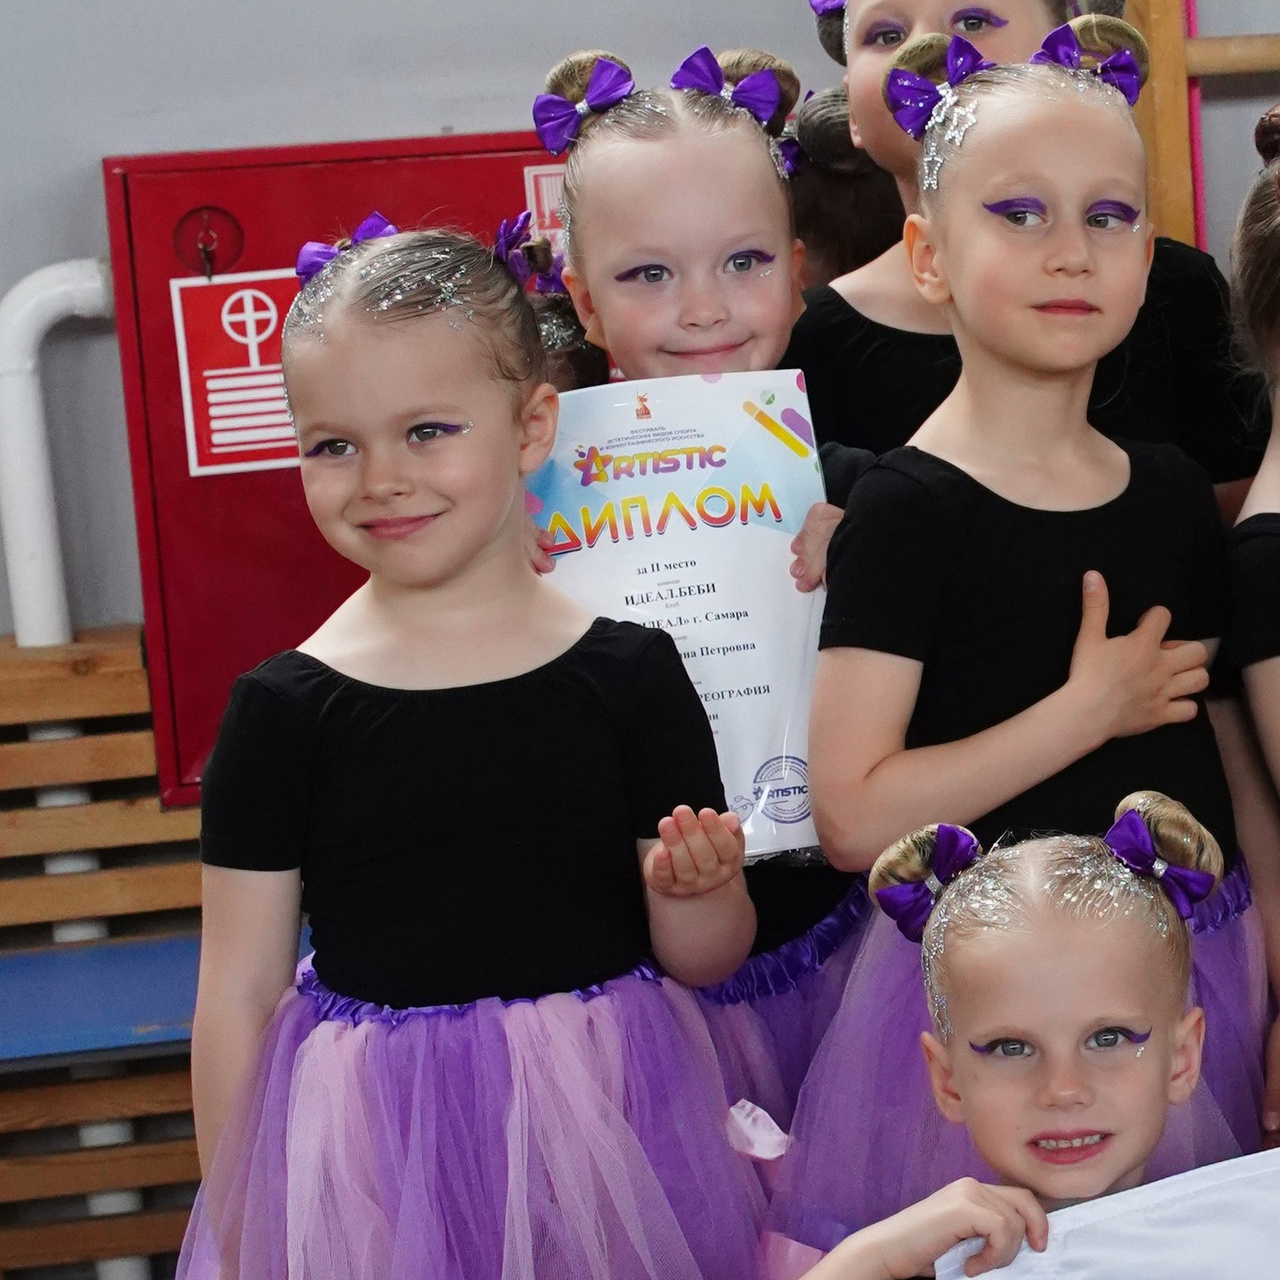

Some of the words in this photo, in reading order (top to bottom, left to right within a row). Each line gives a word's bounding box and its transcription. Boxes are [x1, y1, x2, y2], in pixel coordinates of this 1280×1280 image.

[573, 444, 727, 487] ARTISTIC
[544, 482, 783, 556] ДИПЛОМ
[636, 566, 648, 576] за
[664, 559, 697, 571] место
[624, 583, 717, 606] ИДЕАЛ.БЕБИ
[705, 608, 749, 623] Самара
[700, 642, 757, 657] Петровна
